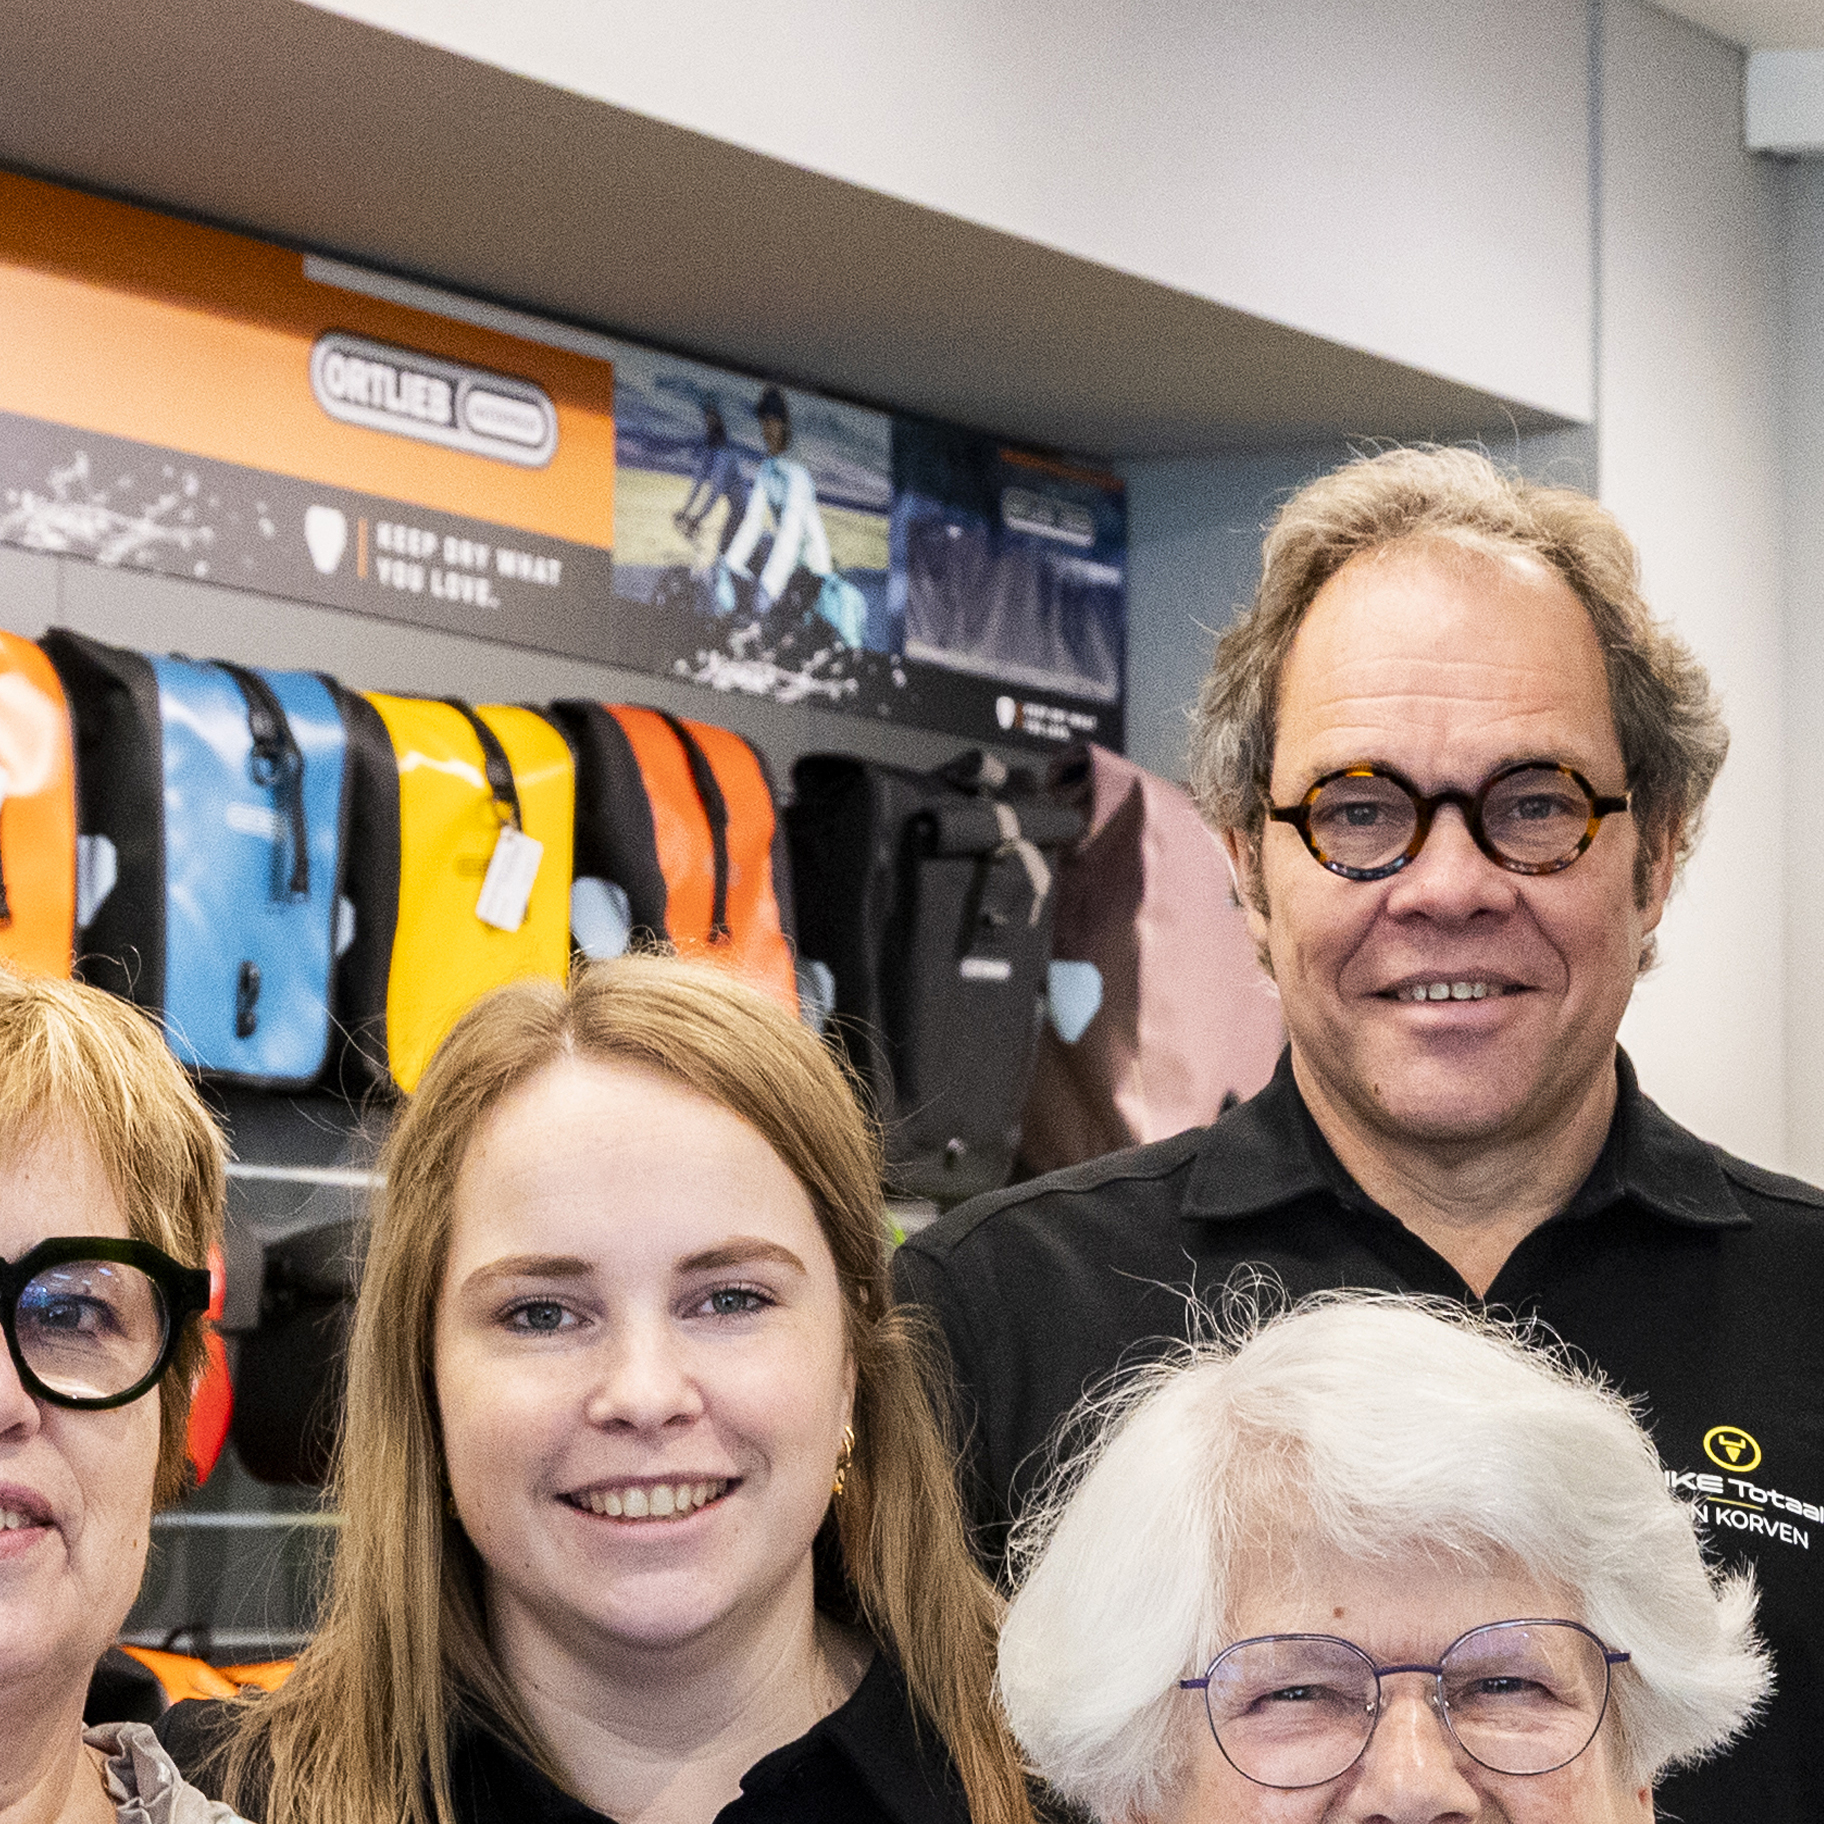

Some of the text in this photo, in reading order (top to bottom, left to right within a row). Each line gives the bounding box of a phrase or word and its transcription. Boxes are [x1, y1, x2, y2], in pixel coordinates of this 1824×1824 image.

[325, 352, 453, 426] ORTLIEB
[375, 556, 425, 593] YOU
[376, 521, 439, 559] KEEP
[495, 549, 563, 587] WHAT
[1664, 1470, 1724, 1495] IKE
[1715, 1506, 1810, 1550] KORVEN
